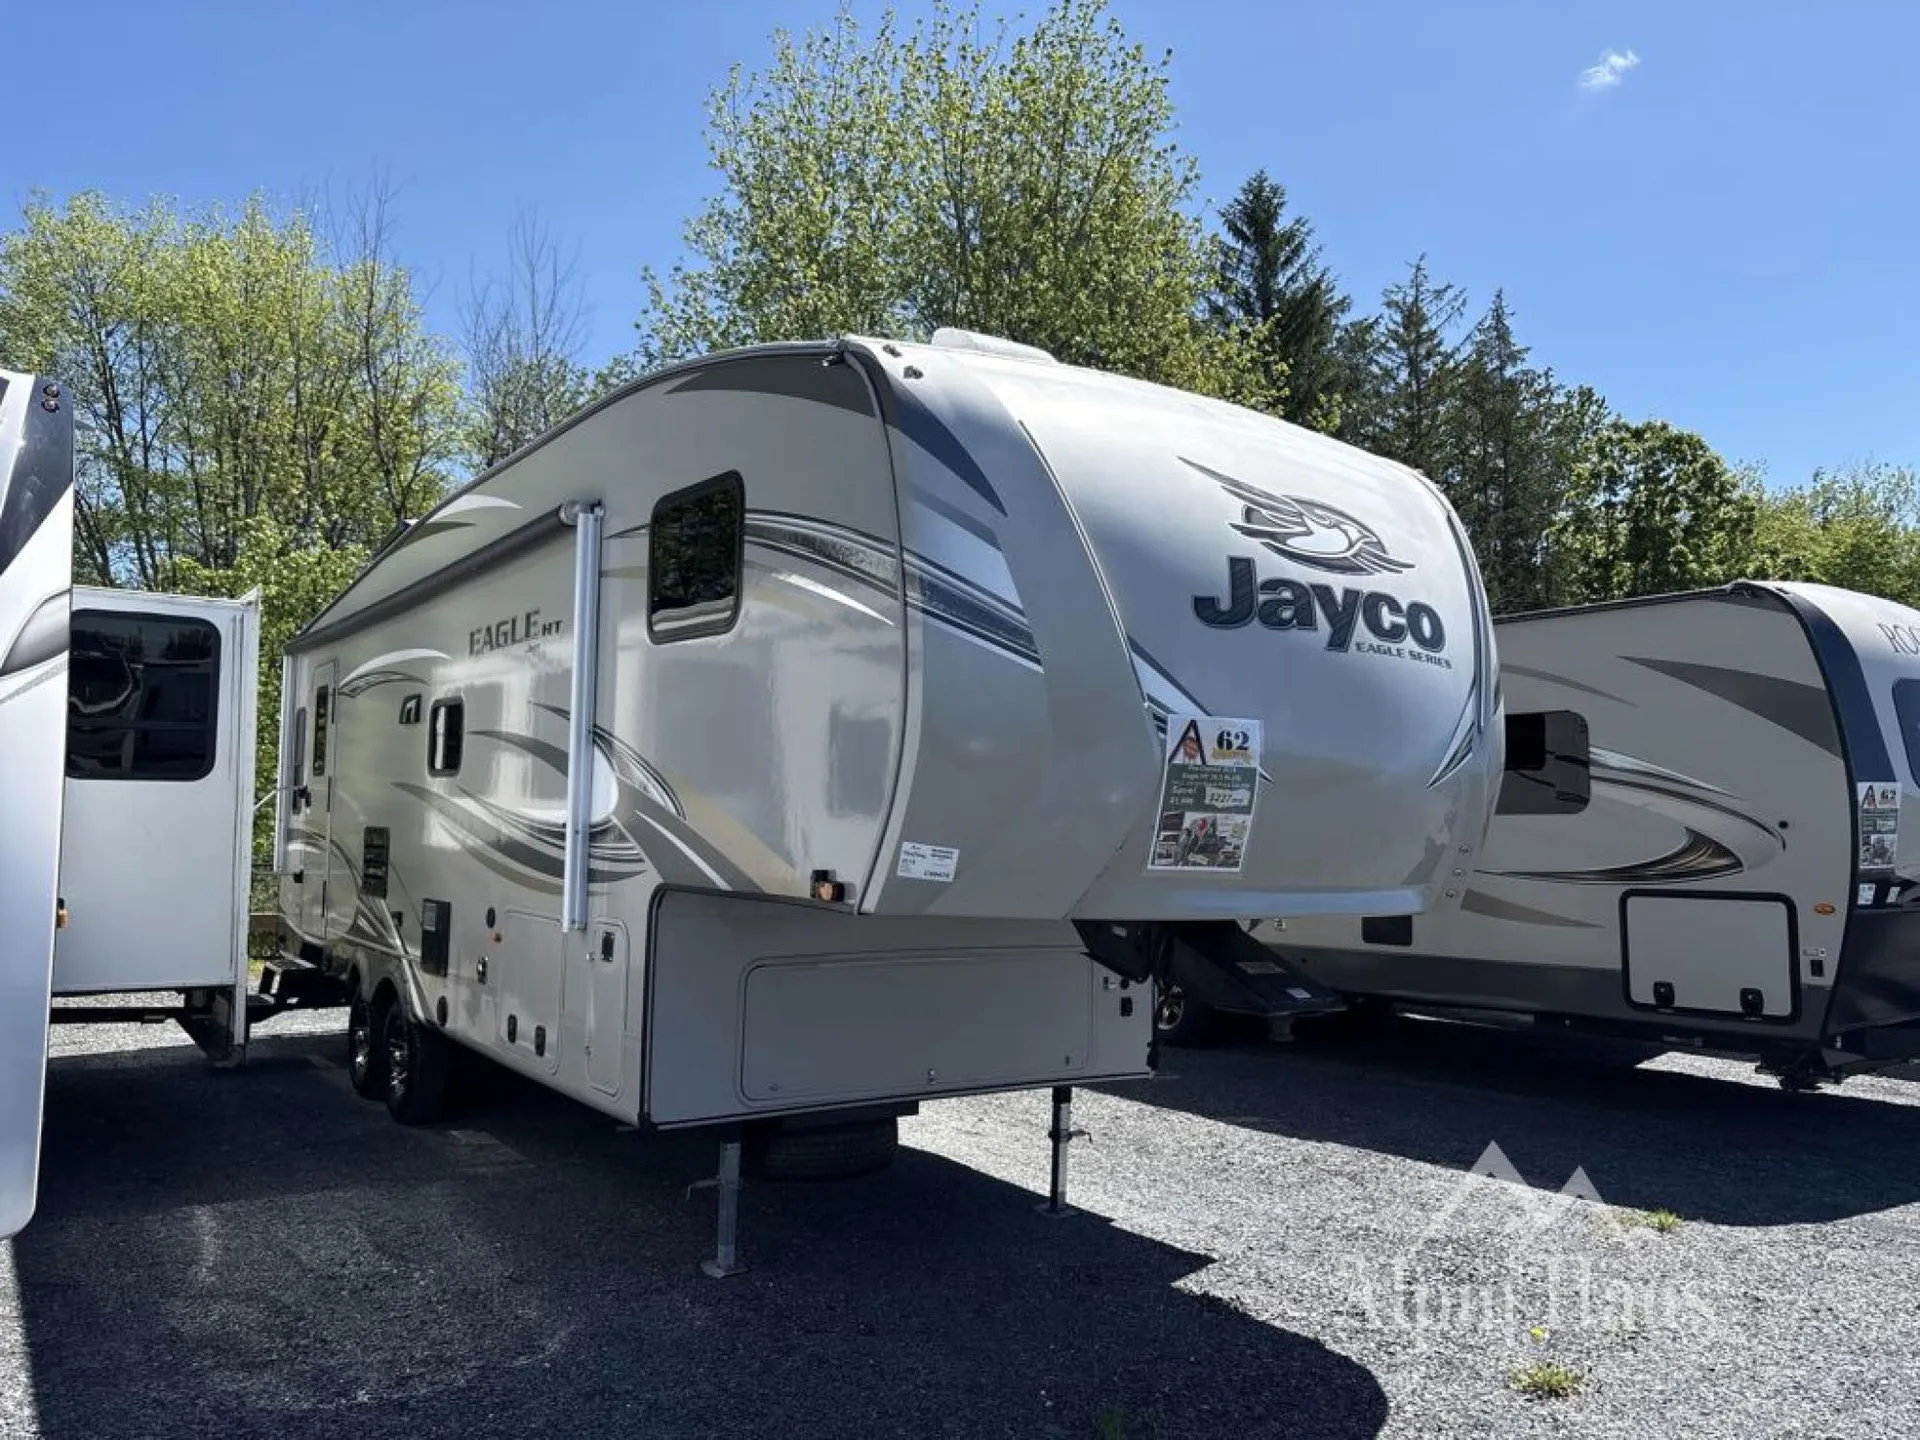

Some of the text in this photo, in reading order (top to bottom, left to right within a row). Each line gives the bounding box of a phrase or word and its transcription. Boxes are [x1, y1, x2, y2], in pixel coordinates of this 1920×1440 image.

[1191, 556, 1446, 653] Jayco
[468, 607, 563, 657] EAGLE HT
[1354, 642, 1452, 670] EAGLE SERIES
[1217, 730, 1250, 751] 62
